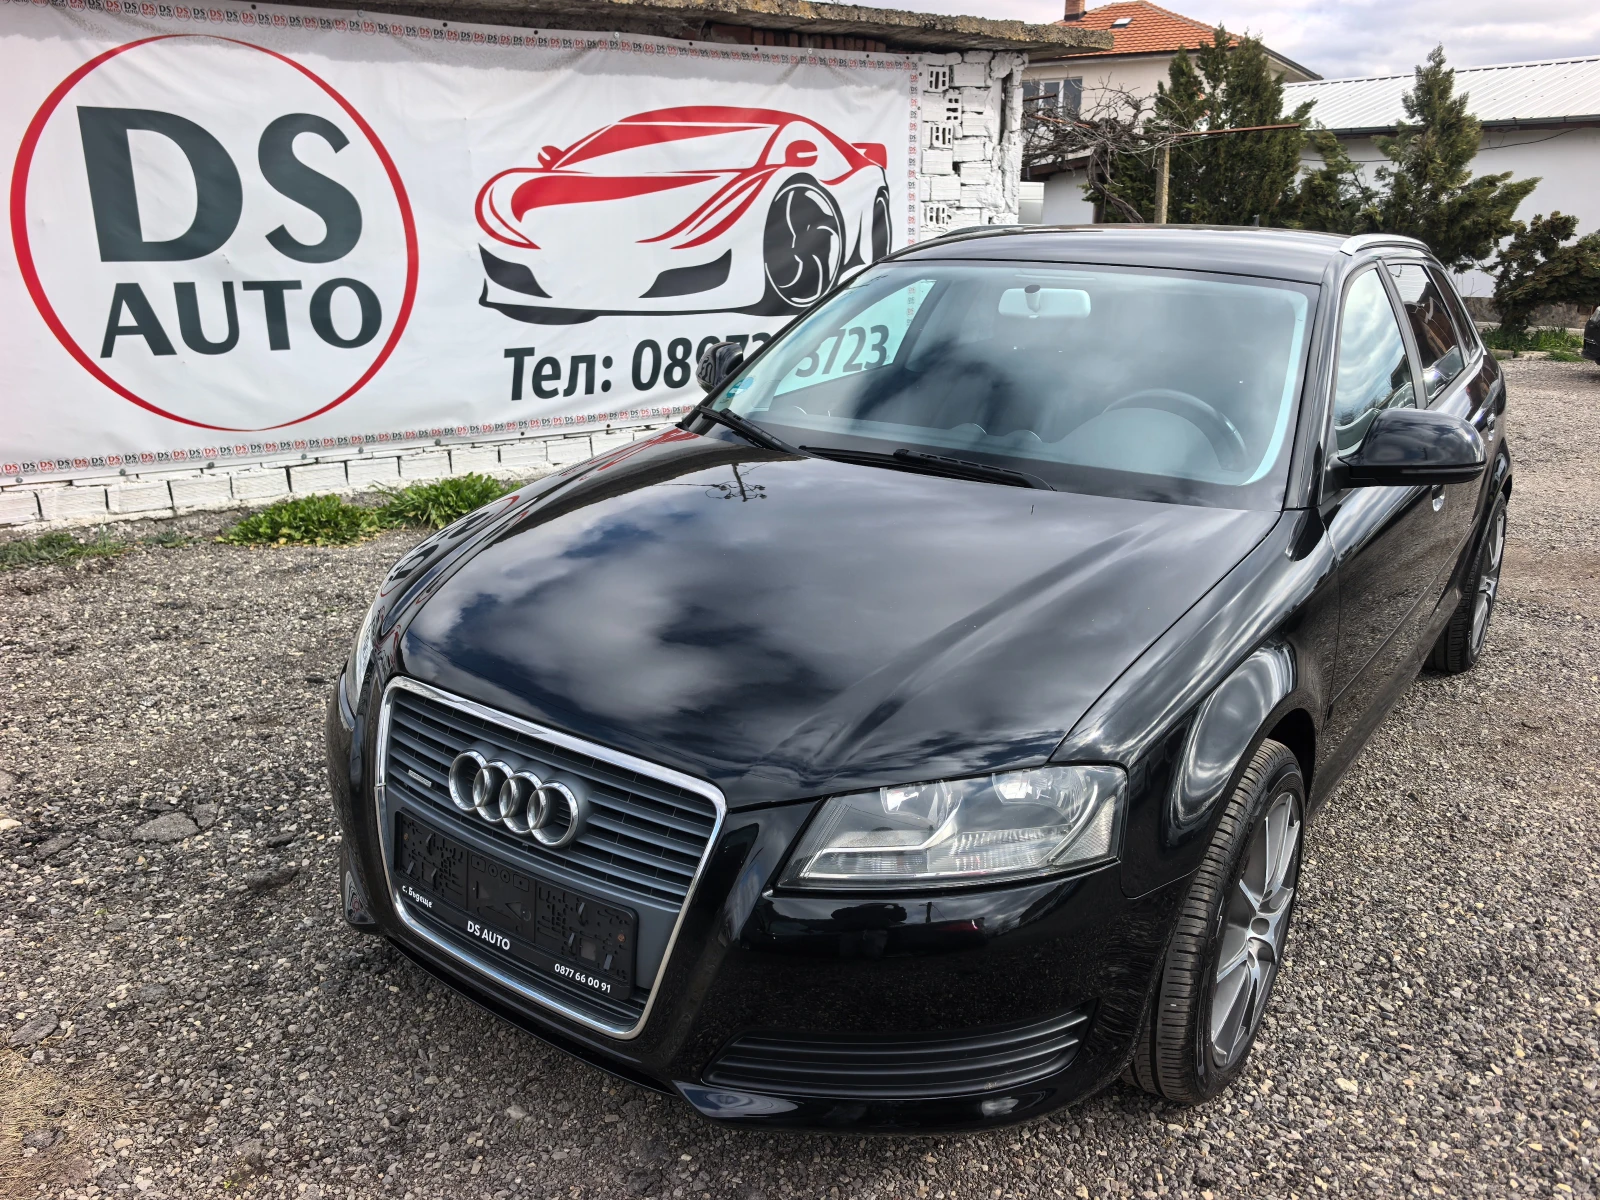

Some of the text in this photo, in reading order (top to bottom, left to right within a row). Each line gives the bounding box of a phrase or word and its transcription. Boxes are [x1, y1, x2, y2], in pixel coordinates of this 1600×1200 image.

[123, 1, 136, 9] DS
[141, 3, 154, 11] DS
[175, 6, 188, 14] DS
[209, 9, 221, 17] DS
[405, 25, 415, 33] DS
[77, 106, 363, 263] DS
[100, 277, 382, 358] AUTO
[504, 347, 613, 400] Тел:
[467, 920, 510, 950] DS AUTO
[554, 963, 611, 993] 0877 66 00 91
